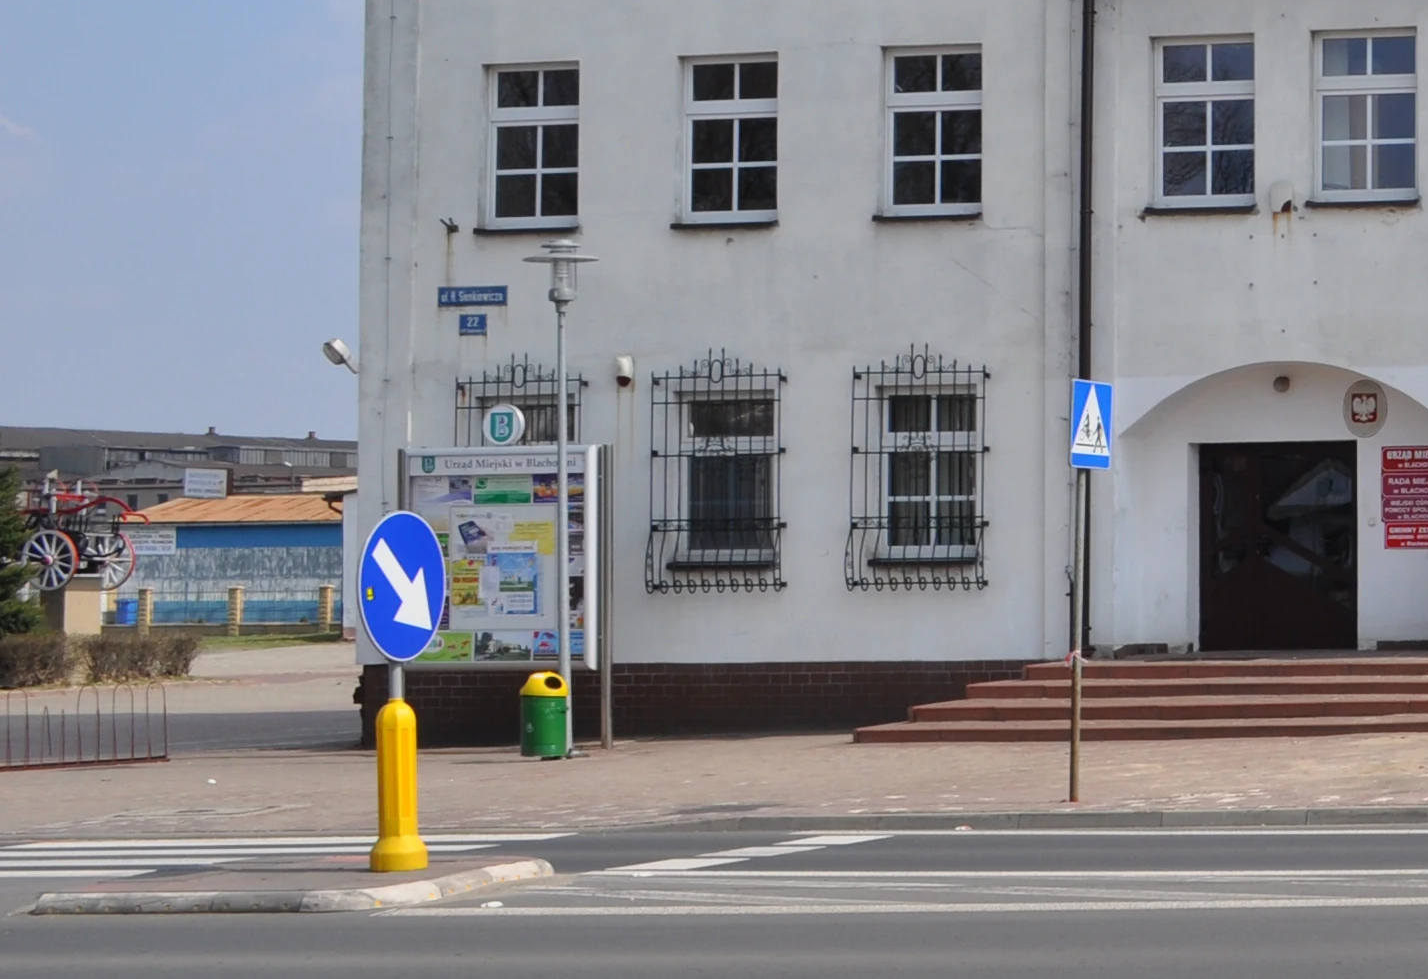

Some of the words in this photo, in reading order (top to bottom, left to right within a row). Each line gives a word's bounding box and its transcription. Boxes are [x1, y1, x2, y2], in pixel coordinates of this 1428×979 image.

[458, 289, 504, 302] Sienkiewicza
[466, 316, 480, 327] 22
[1386, 450, 1412, 461] URZĄD
[444, 458, 473, 470] Urząd
[475, 457, 513, 471] Miejski
[514, 460, 524, 468] w
[526, 457, 577, 468] Blachoni
[1387, 477, 1411, 485] RADA
